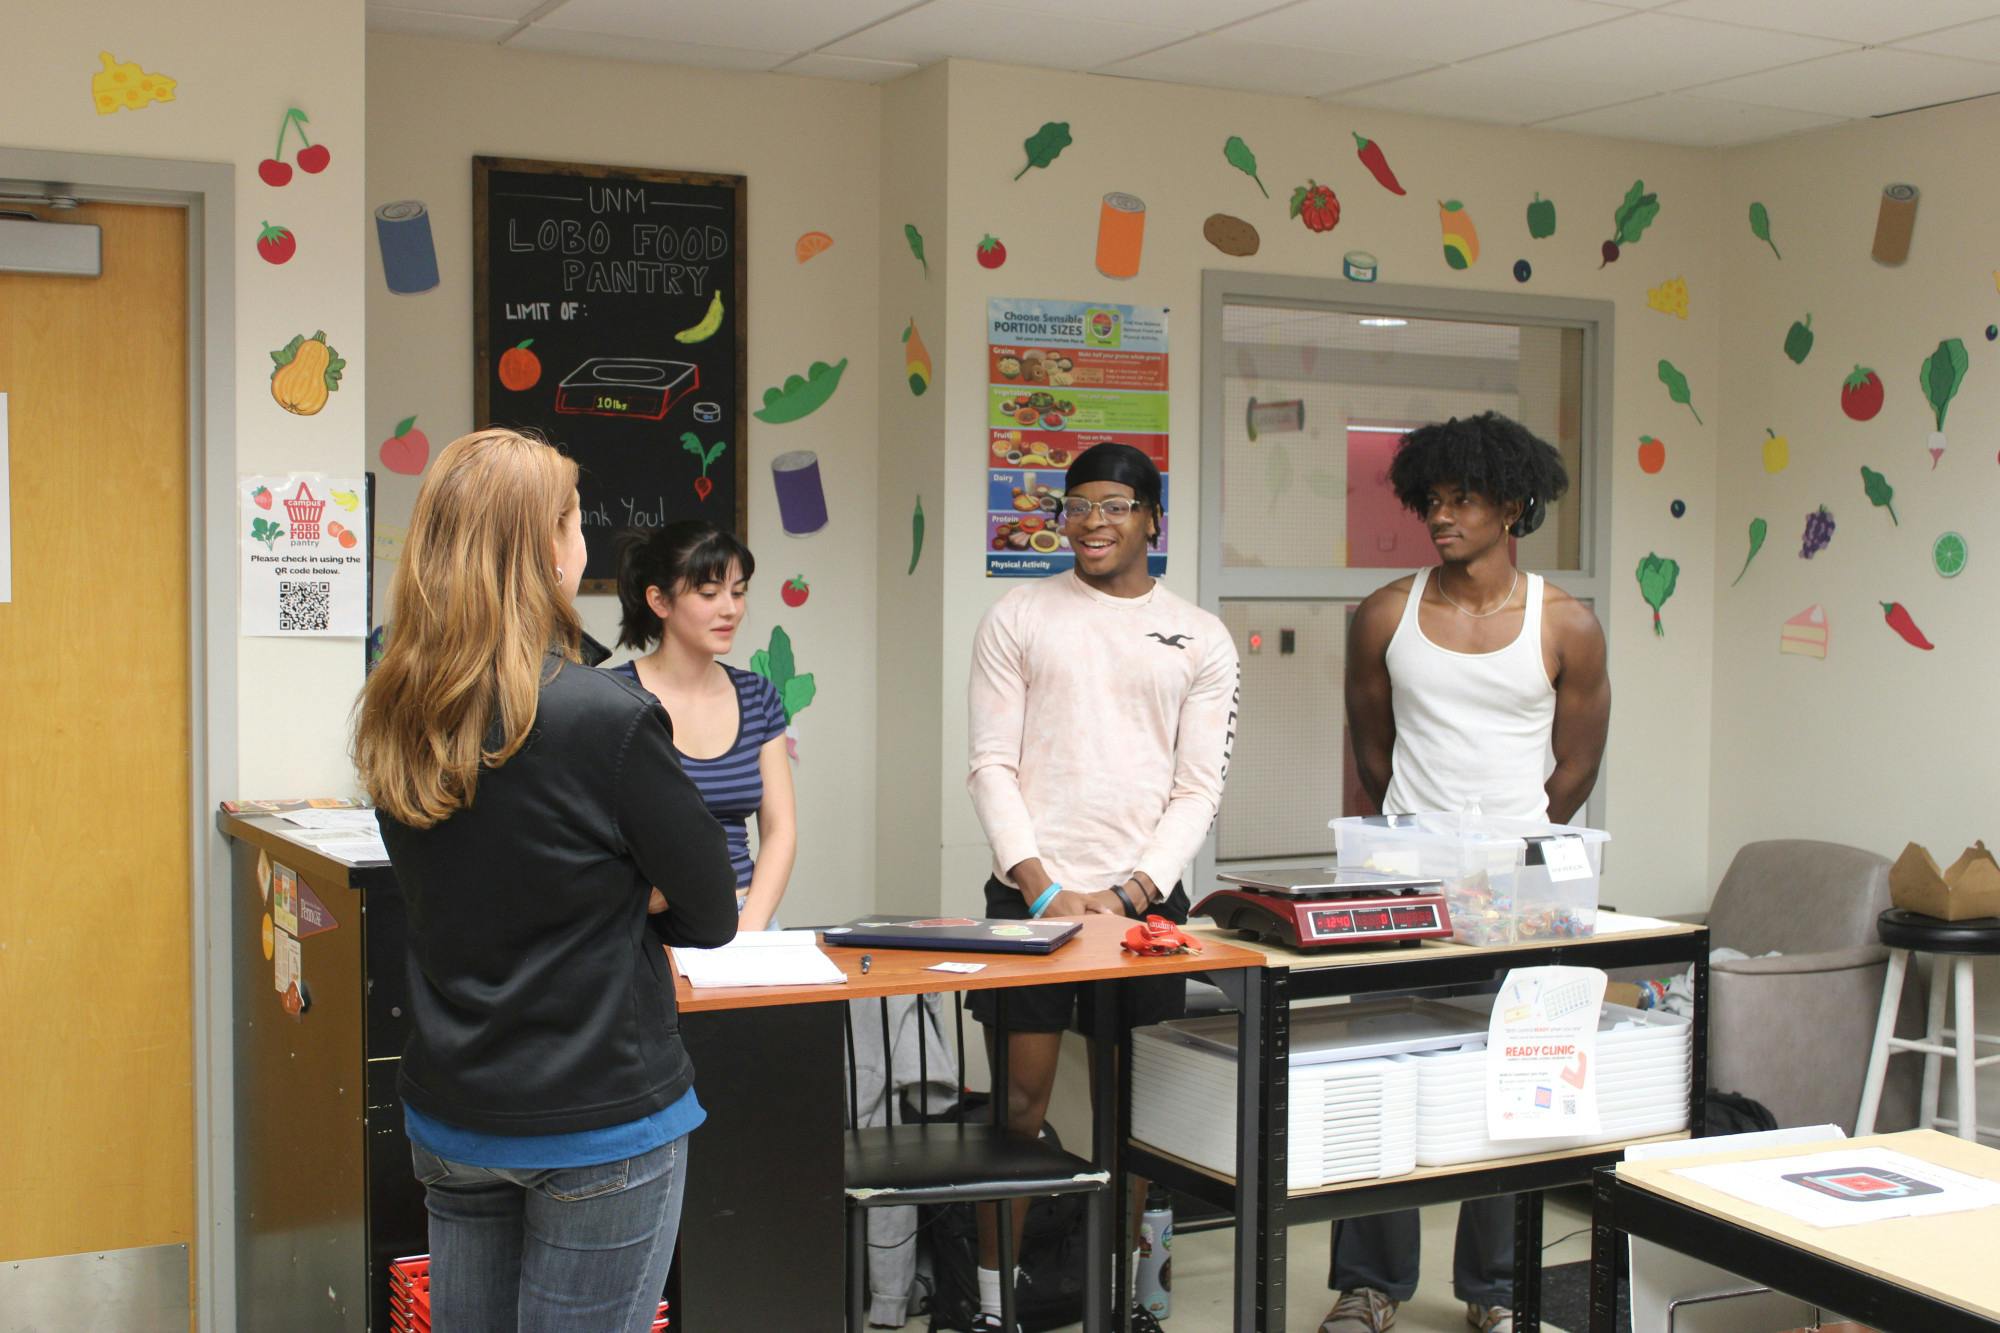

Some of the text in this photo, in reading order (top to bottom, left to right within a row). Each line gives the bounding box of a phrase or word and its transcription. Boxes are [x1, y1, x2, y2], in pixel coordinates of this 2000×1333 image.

[589, 185, 648, 214] UNM
[508, 218, 728, 262] LOBO FOOD
[562, 259, 709, 297] PANTRY
[505, 302, 589, 321] LIMIT OF:
[1004, 311, 1083, 325] Choose Sensible
[993, 321, 1083, 337] PORTION SIZES
[992, 346, 1016, 355] Grains
[993, 473, 1013, 483] Dairy
[580, 496, 665, 528] ank You!
[991, 515, 1019, 523] Protein
[290, 523, 320, 532] LOBO
[290, 531, 320, 540] FOOD
[290, 539, 320, 548] pantry
[250, 555, 361, 565] Please check in using the
[991, 560, 1050, 570] Physical Activity
[274, 567, 341, 576] QR code below.
[1505, 1045, 1576, 1057] READY CLINIC
